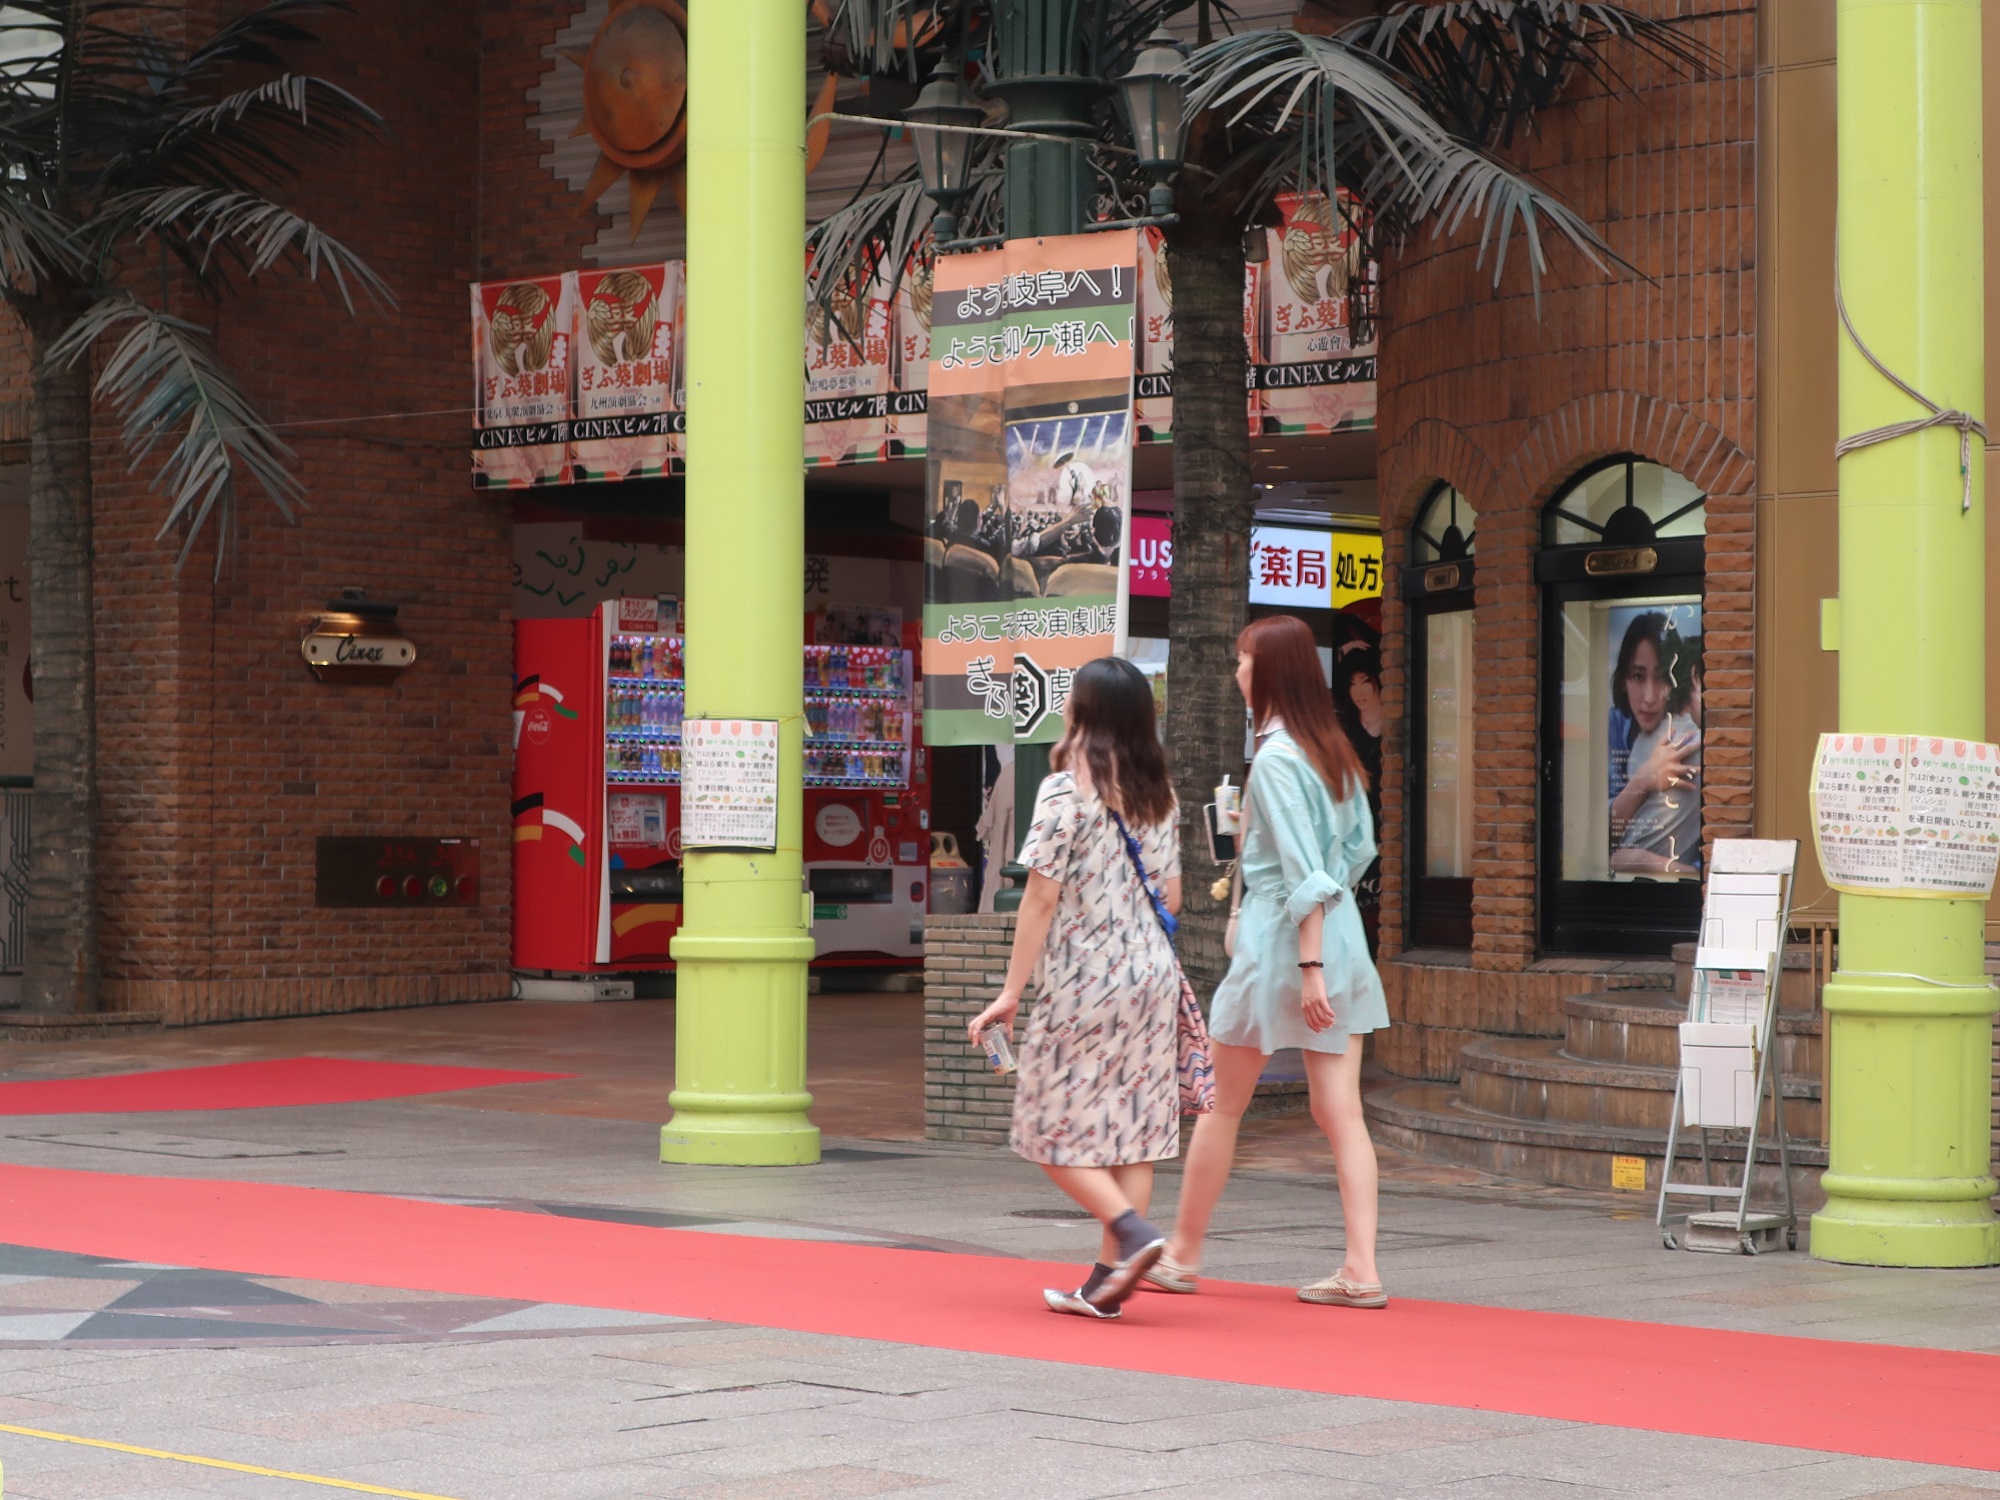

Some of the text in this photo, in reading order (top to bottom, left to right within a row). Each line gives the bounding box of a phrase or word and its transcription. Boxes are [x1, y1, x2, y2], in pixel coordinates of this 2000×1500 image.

[957, 264, 1123, 318] よう岐阜へ！
[486, 369, 567, 401] ぎふ葵劇場
[580, 359, 670, 391] ぎふ葵劇場
[1250, 540, 1327, 590] 薬局
[1335, 551, 1380, 592] 処方
